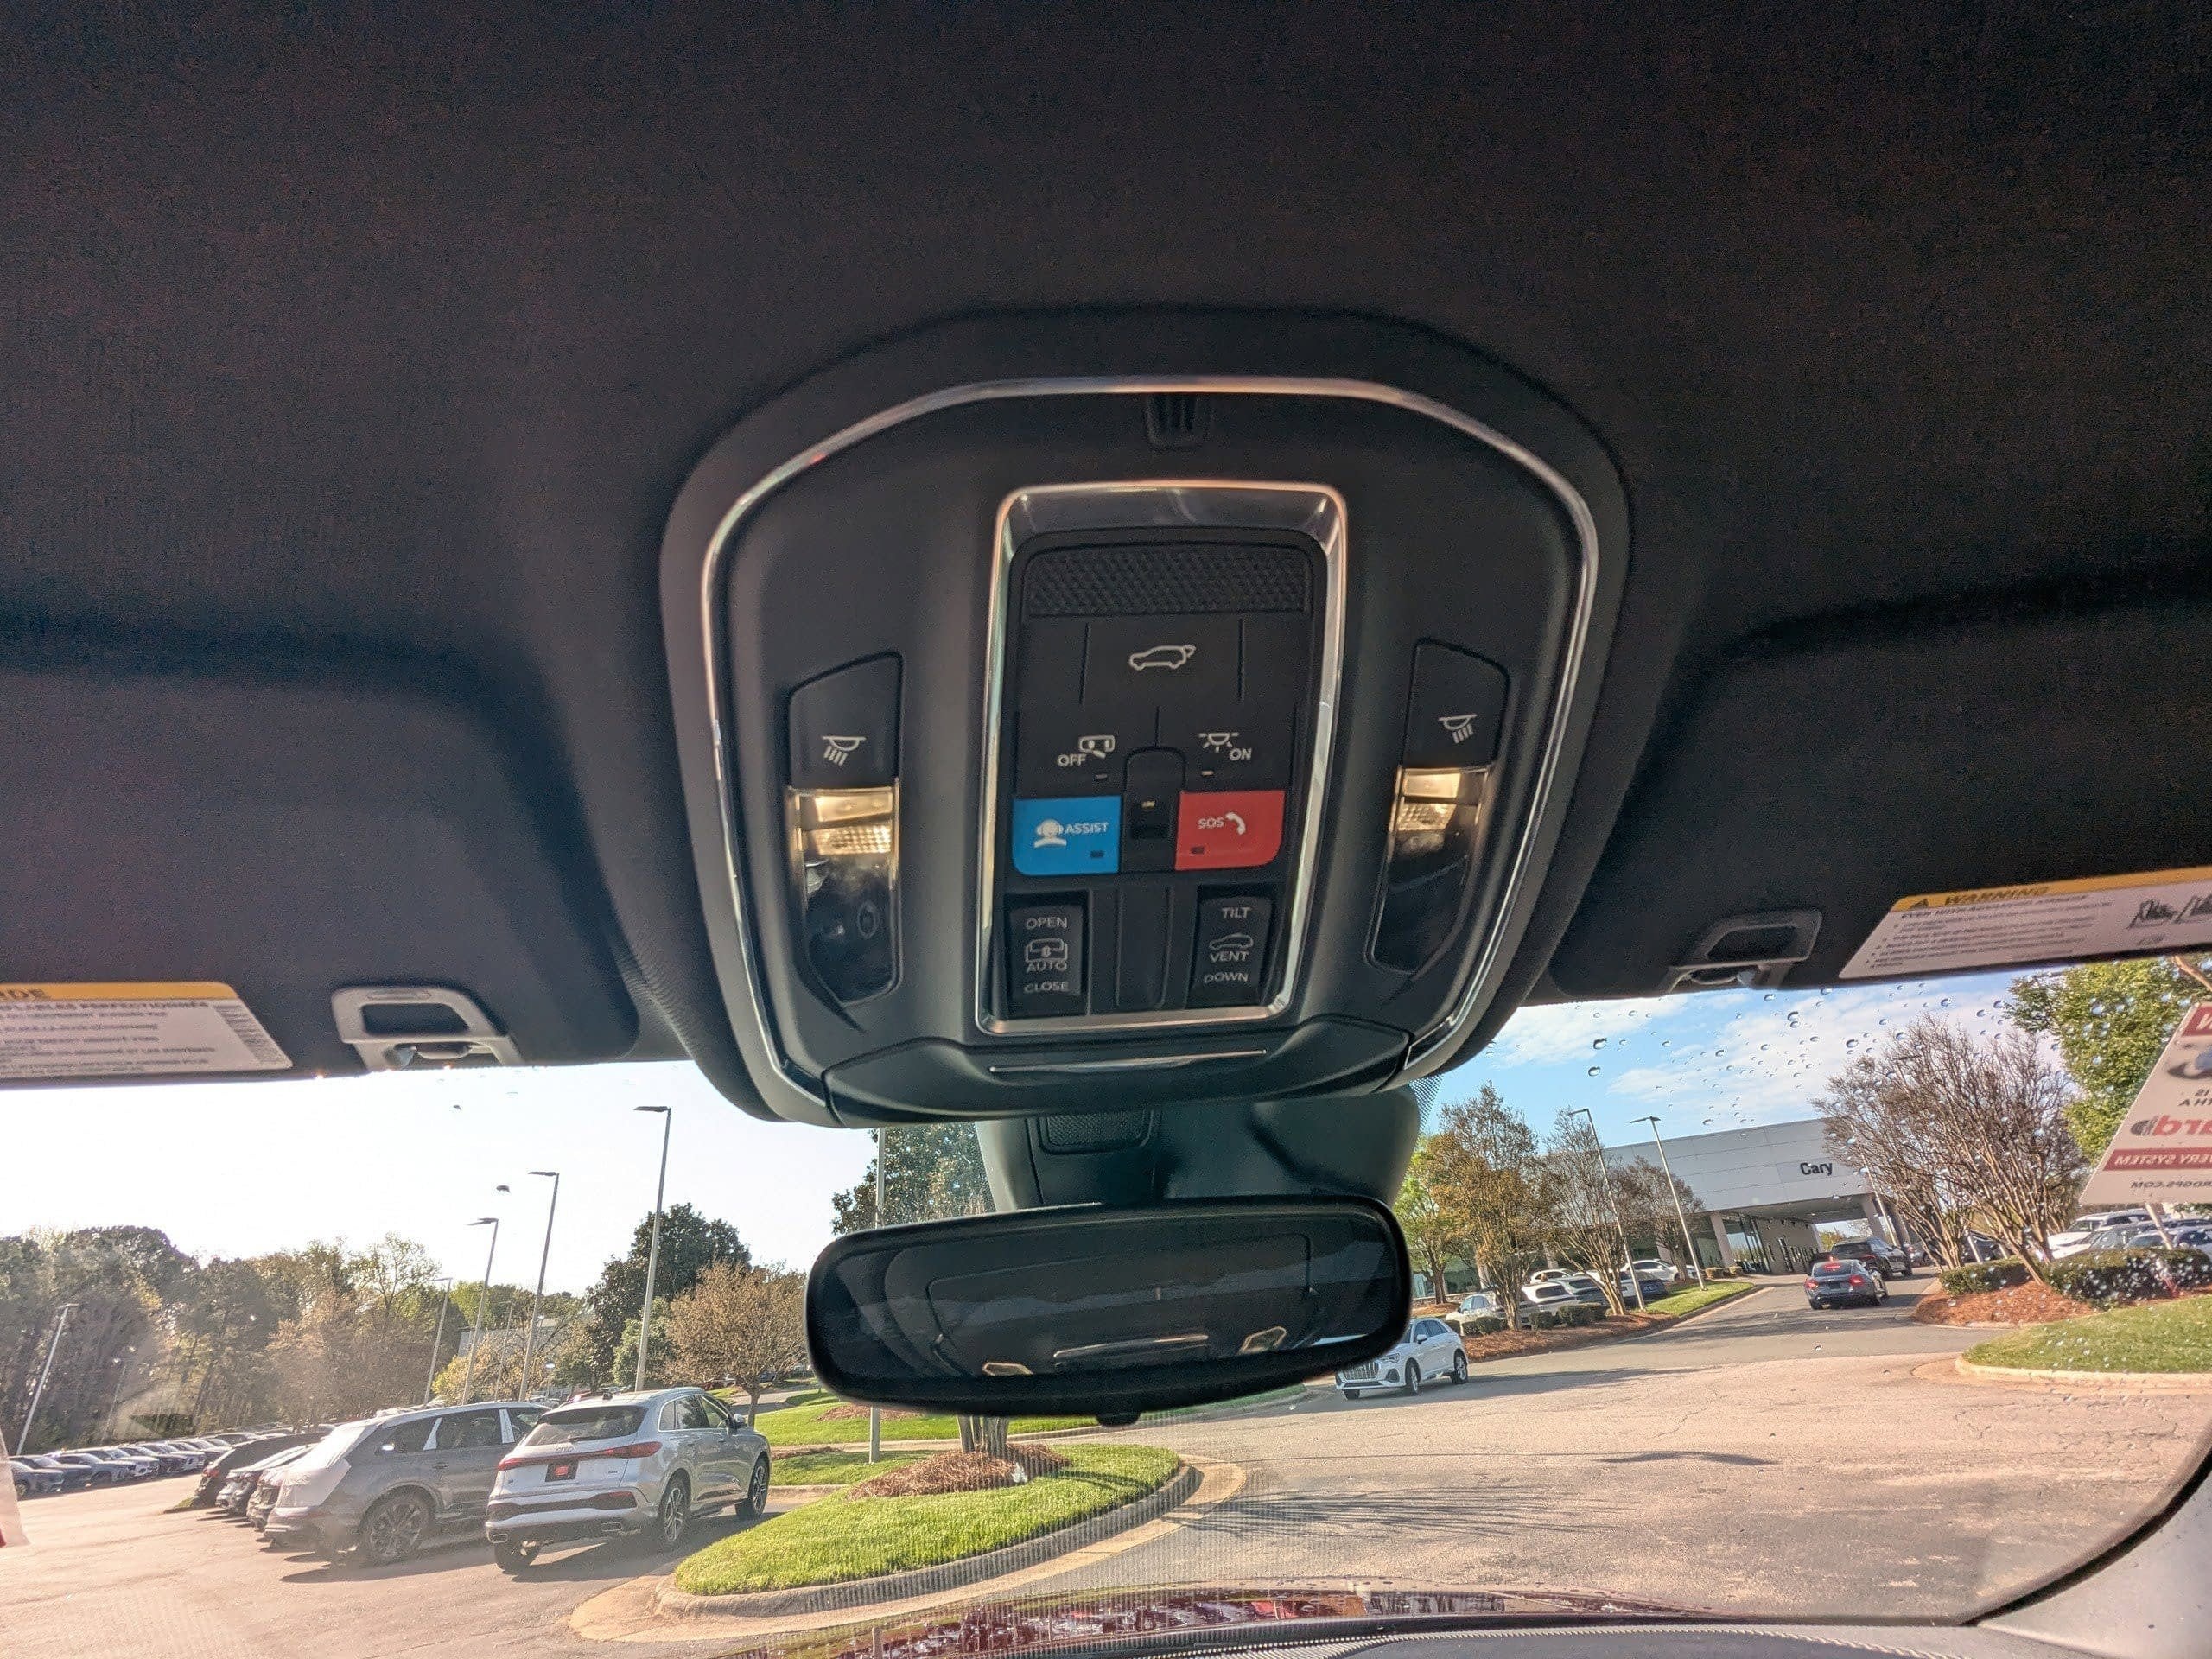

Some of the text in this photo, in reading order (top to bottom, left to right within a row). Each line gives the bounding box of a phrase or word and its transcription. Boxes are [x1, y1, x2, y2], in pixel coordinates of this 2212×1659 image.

[1057, 754, 1086, 767] OFF
[1229, 747, 1252, 761] ON
[1065, 822, 1109, 835] ASSIST
[1198, 817, 1225, 830] SOS
[1944, 886, 2049, 906] WARNING
[1221, 907, 1252, 919] TILT
[1025, 917, 1068, 930] OPEN
[1209, 950, 1249, 963] VENT
[1026, 961, 1068, 973] AUTO
[1204, 972, 1249, 984] DOWN
[1024, 981, 1070, 994] CLOSE
[1799, 1160, 1834, 1177] Cary
